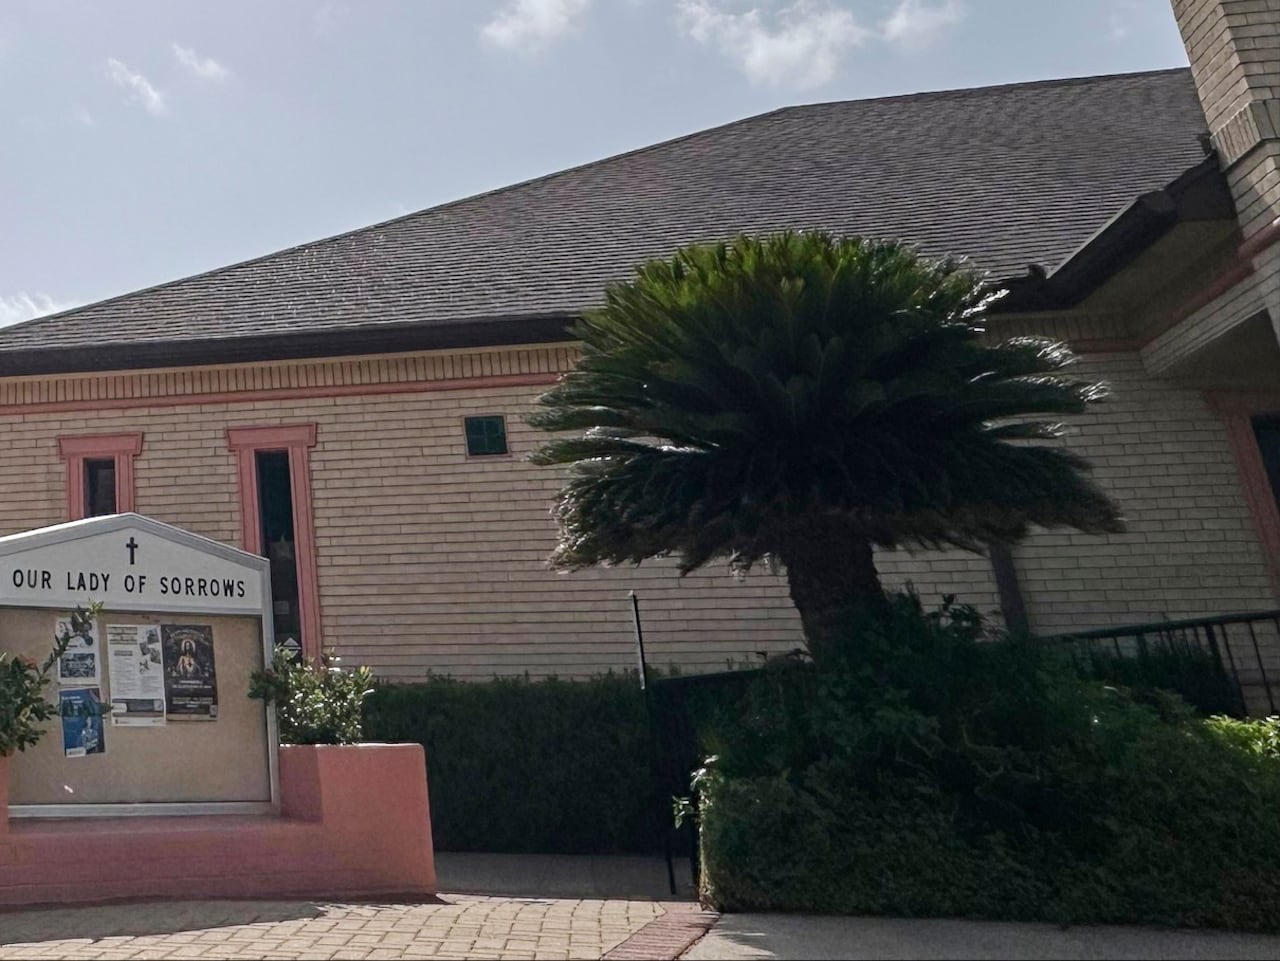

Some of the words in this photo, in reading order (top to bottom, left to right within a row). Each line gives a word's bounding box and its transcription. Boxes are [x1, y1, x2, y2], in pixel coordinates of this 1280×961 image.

[12, 568, 52, 590] OUR
[67, 571, 111, 593] LADY
[123, 574, 147, 594] OF
[159, 576, 247, 598] SORROWS
